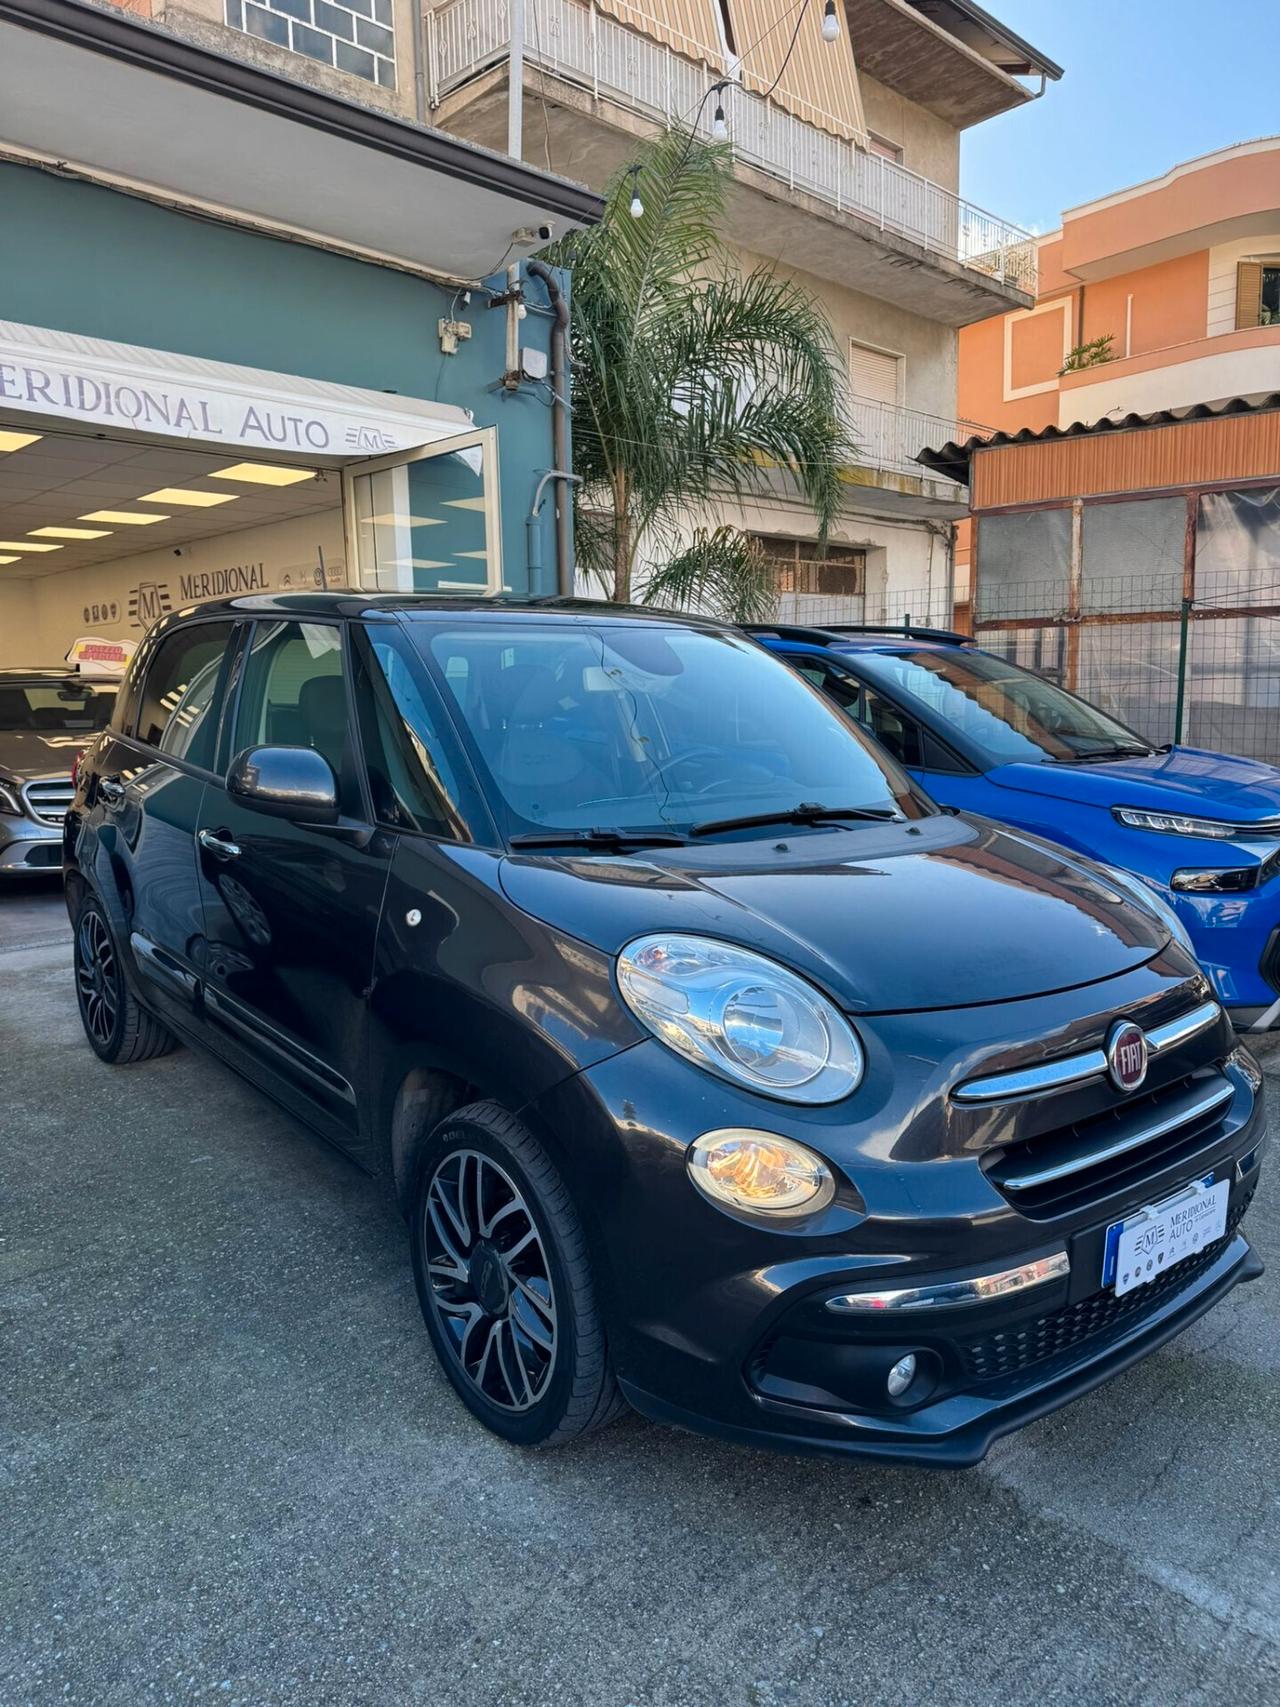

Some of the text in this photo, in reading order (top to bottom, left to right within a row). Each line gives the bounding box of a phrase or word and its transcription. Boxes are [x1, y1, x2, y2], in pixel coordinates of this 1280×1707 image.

[240, 406, 328, 447] AUTO
[180, 563, 269, 600] MERIDIONAL
[1121, 1041, 1141, 1075] FIAT
[1170, 1195, 1217, 1228] MERIDIONAL
[1169, 1220, 1193, 1242] AUTO
